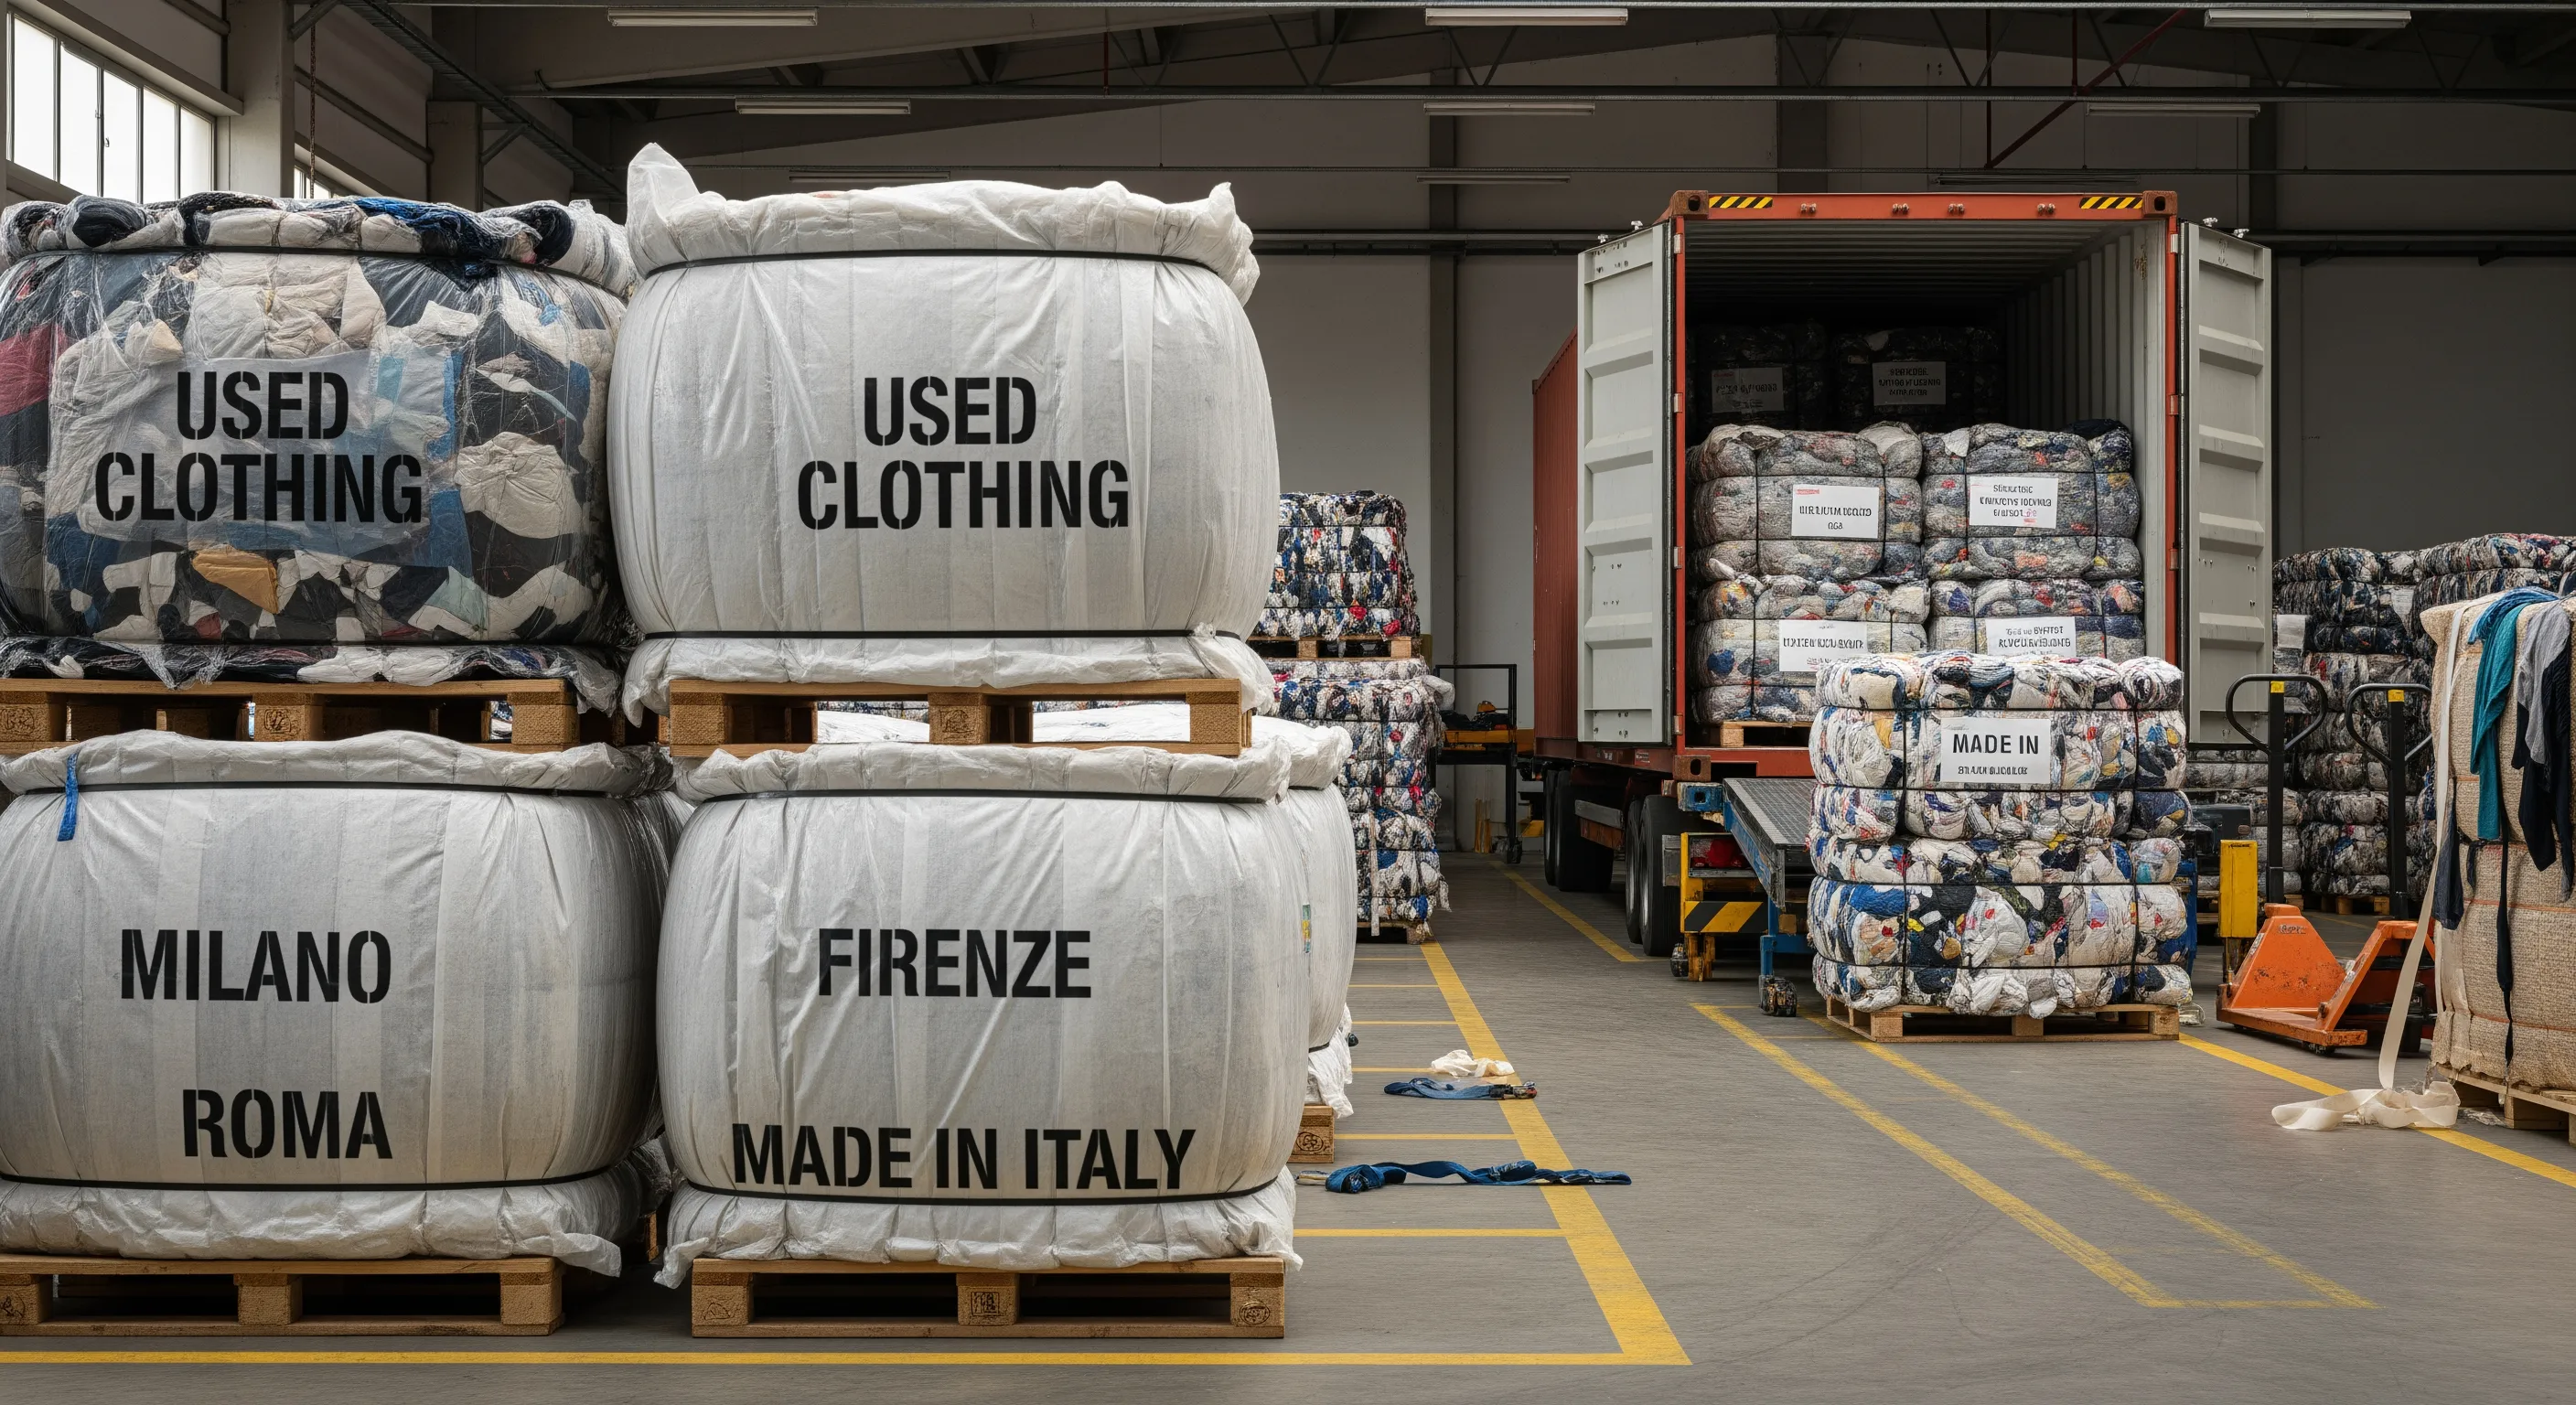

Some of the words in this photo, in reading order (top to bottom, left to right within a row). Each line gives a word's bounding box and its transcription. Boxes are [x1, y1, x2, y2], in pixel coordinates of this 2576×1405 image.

[177, 371, 348, 440] USED
[864, 376, 1036, 446] USED
[95, 452, 422, 524] CLOTHING
[798, 459, 1129, 531] CLOTHING
[1953, 734, 2012, 754] MADE
[2019, 735, 2039, 755] IN
[121, 928, 392, 1004] MILANO
[819, 928, 1091, 999] FIRENZE
[182, 1089, 393, 1160] ROMA
[732, 1122, 913, 1188] MADE
[936, 1128, 998, 1190] IN
[1025, 1128, 1197, 1190] ITALY
